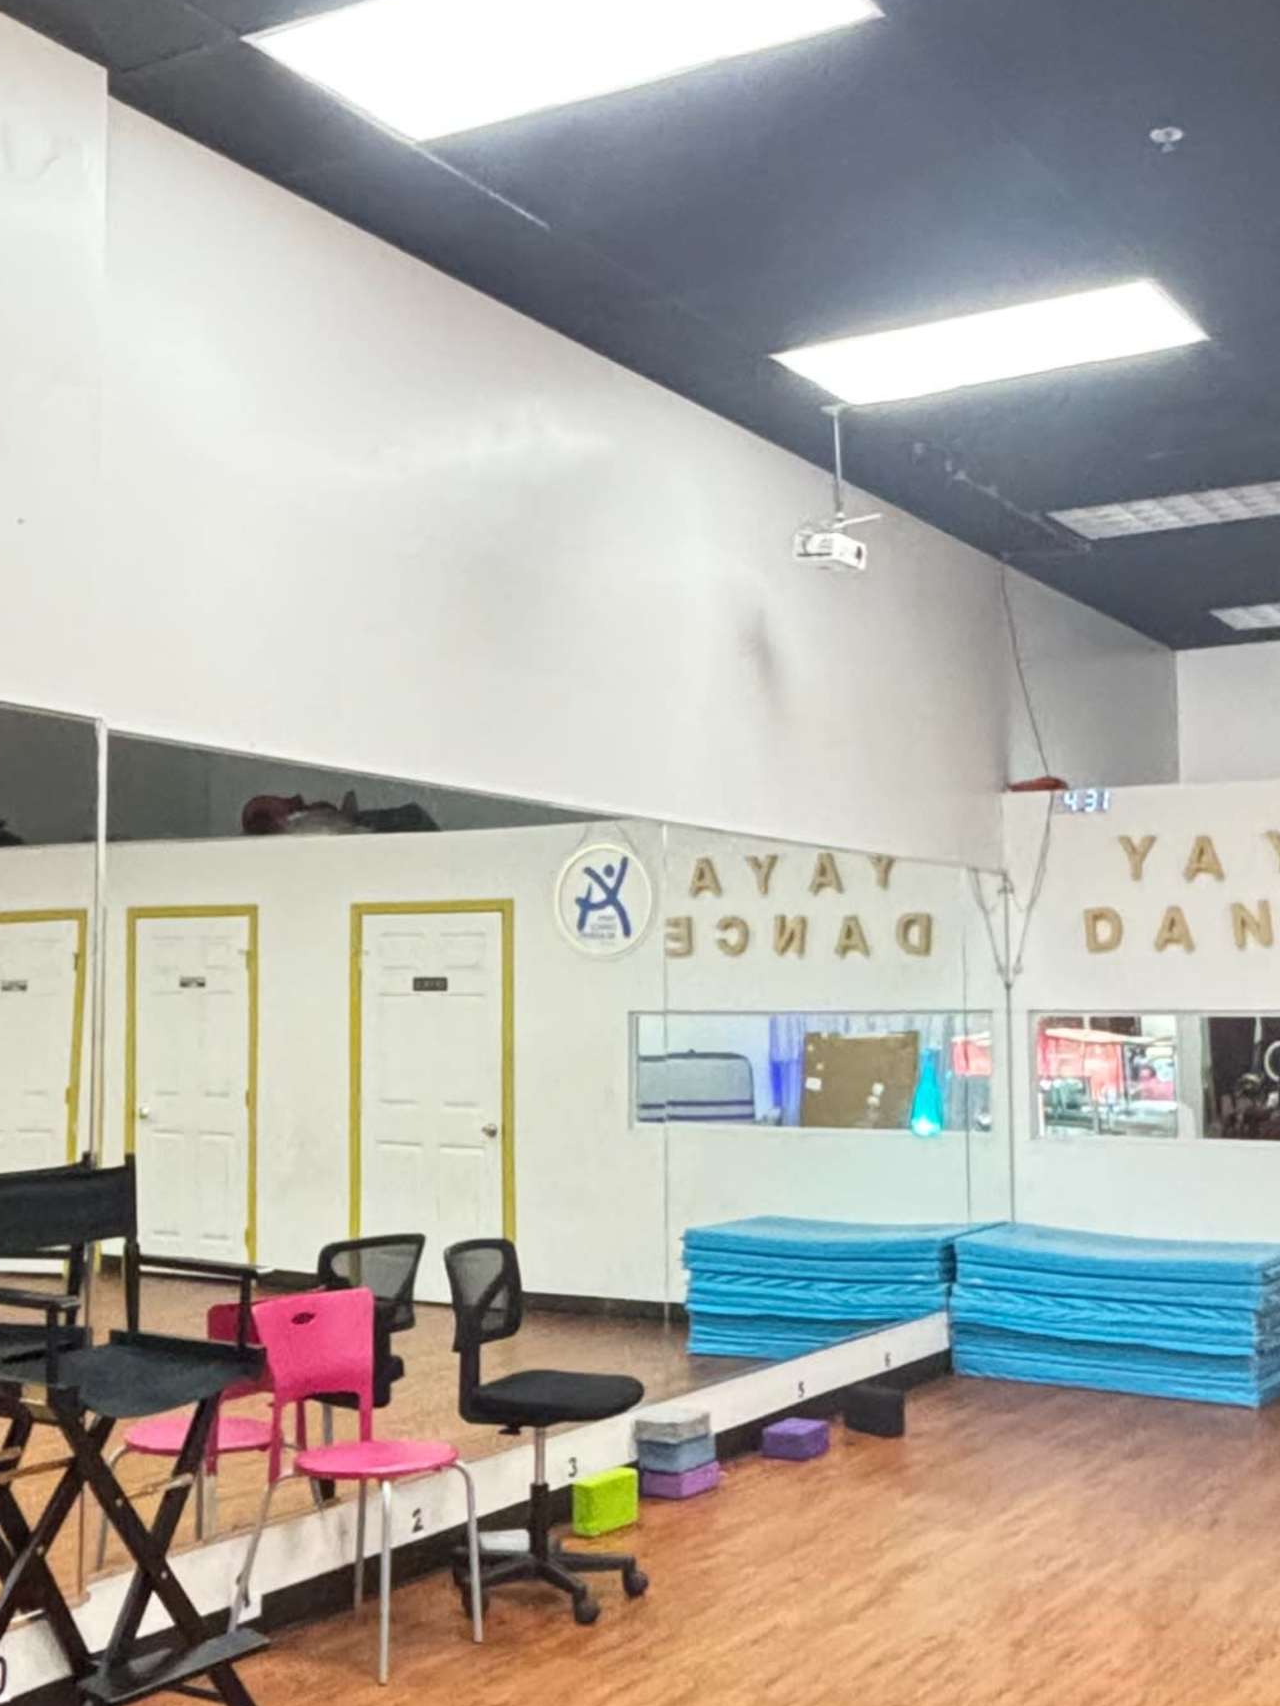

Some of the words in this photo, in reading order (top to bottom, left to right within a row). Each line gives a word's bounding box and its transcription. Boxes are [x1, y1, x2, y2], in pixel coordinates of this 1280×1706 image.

[797, 1381, 806, 1398] 5
[567, 1457, 578, 1478] 3
[411, 1508, 424, 1533] 2
